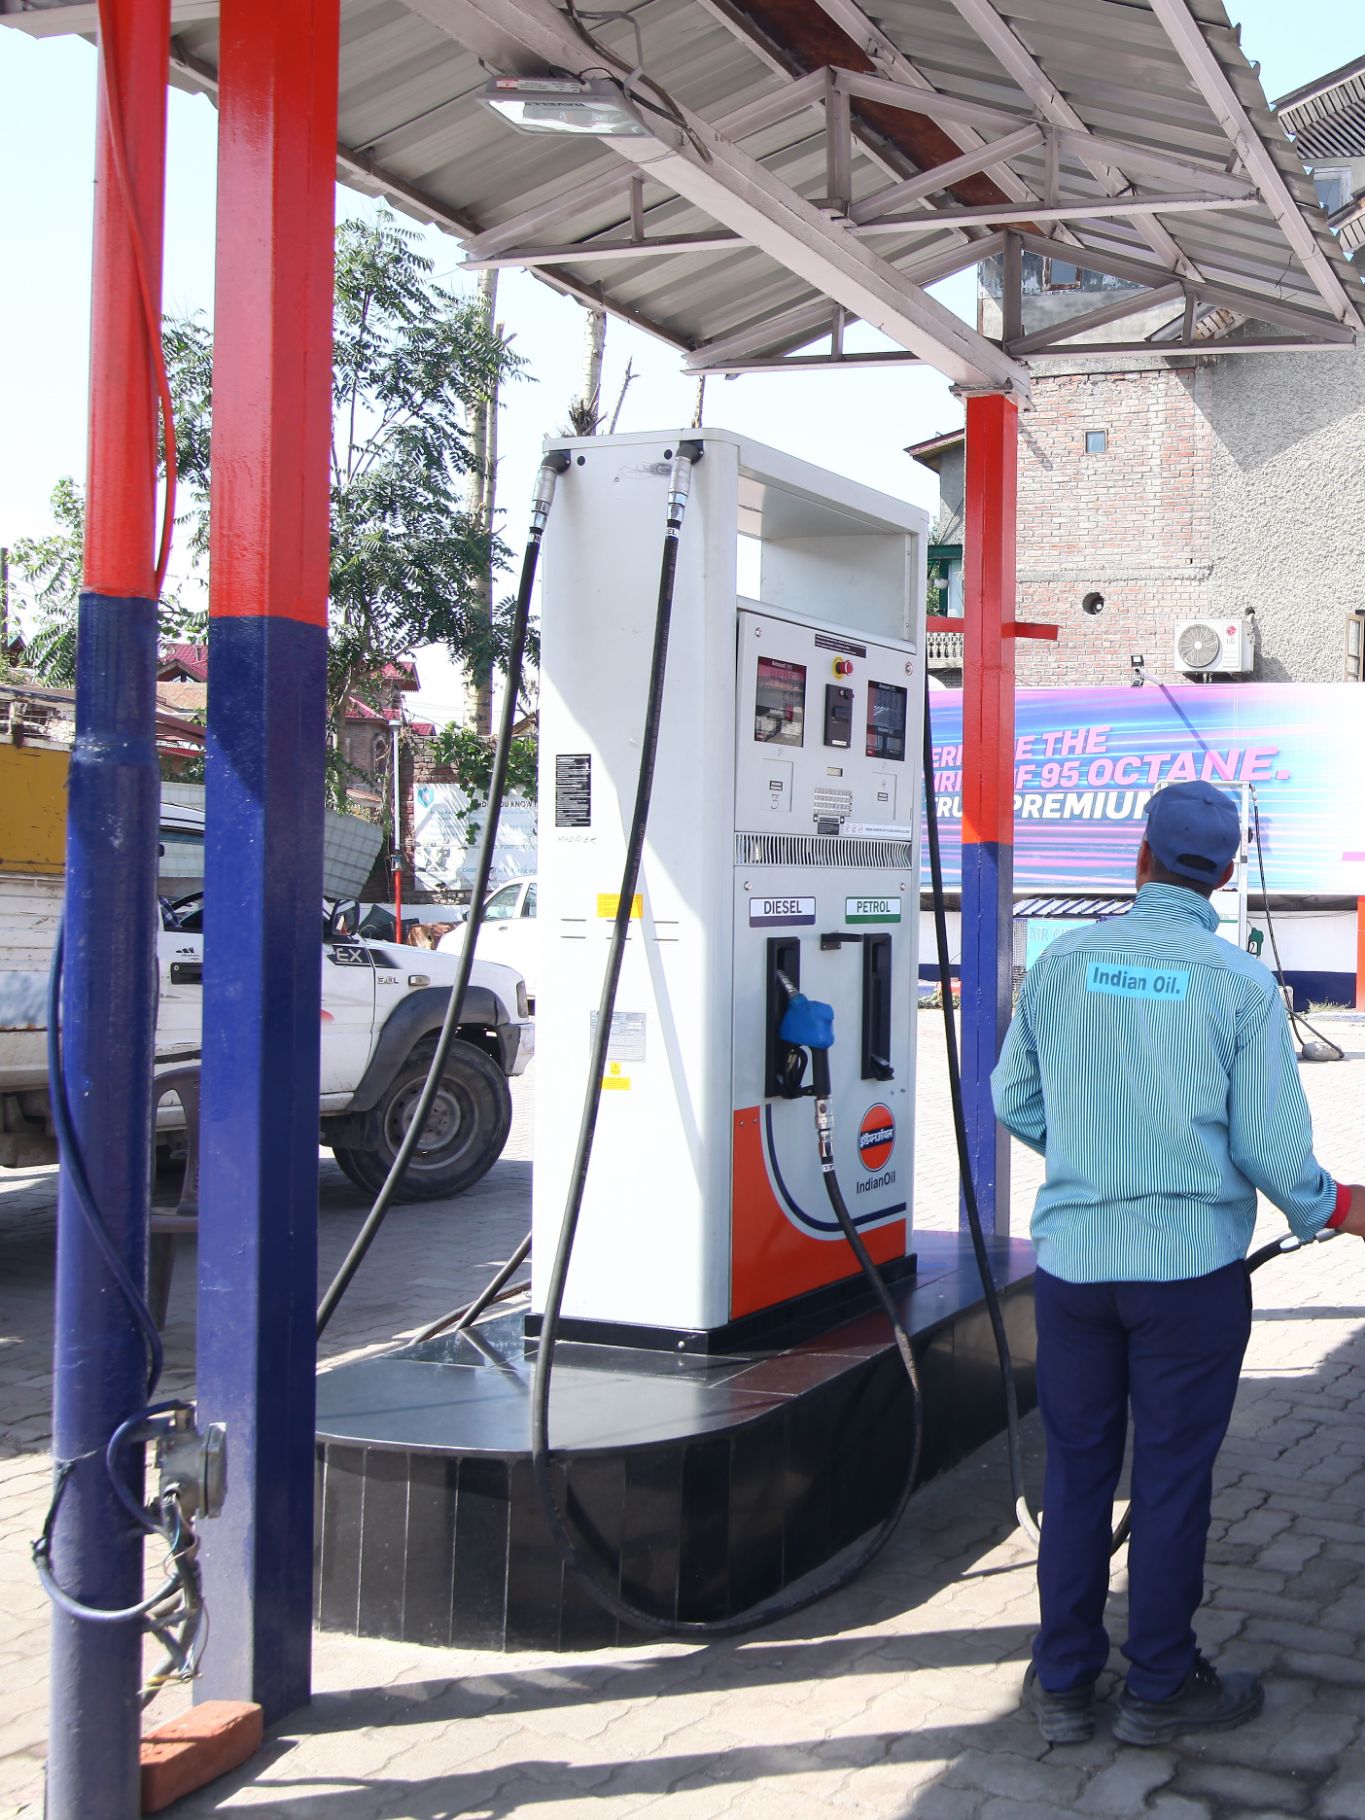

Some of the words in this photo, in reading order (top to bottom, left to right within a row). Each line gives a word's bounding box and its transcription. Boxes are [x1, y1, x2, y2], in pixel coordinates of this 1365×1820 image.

[1042, 725, 1111, 758] THE
[1040, 760, 1081, 788] 95
[1087, 746, 1290, 786] OCTANE.
[764, 900, 802, 914] DIESEL
[856, 900, 891, 913] PETROL
[336, 948, 362, 962] EX
[1093, 966, 1147, 990] Indian
[1153, 976, 1180, 994] Oil.
[856, 1170, 896, 1194] IndianOil
